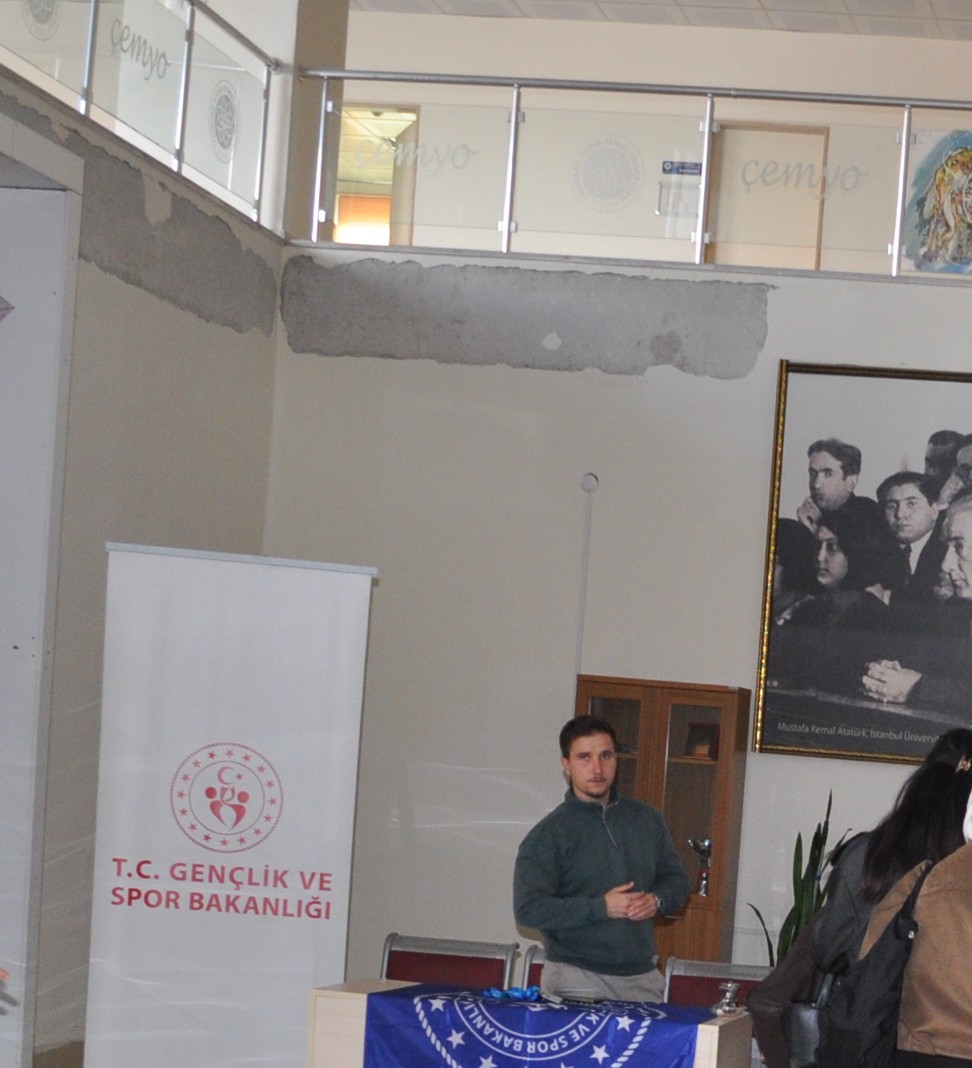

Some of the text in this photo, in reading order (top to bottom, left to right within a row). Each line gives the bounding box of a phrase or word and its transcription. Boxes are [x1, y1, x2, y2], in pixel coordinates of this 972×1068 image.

[740, 158, 870, 200] çemyo
[777, 721, 809, 733] Mustafa
[810, 725, 836, 735] Kemal
[837, 726, 868, 739] Atatürk,
[111, 857, 333, 892] T.C. GENÇLİK VE
[110, 886, 332, 920] SPOR BAKANLIĞI
[526, 1035, 568, 1054] SPOR
[569, 1023, 590, 1042] VE
